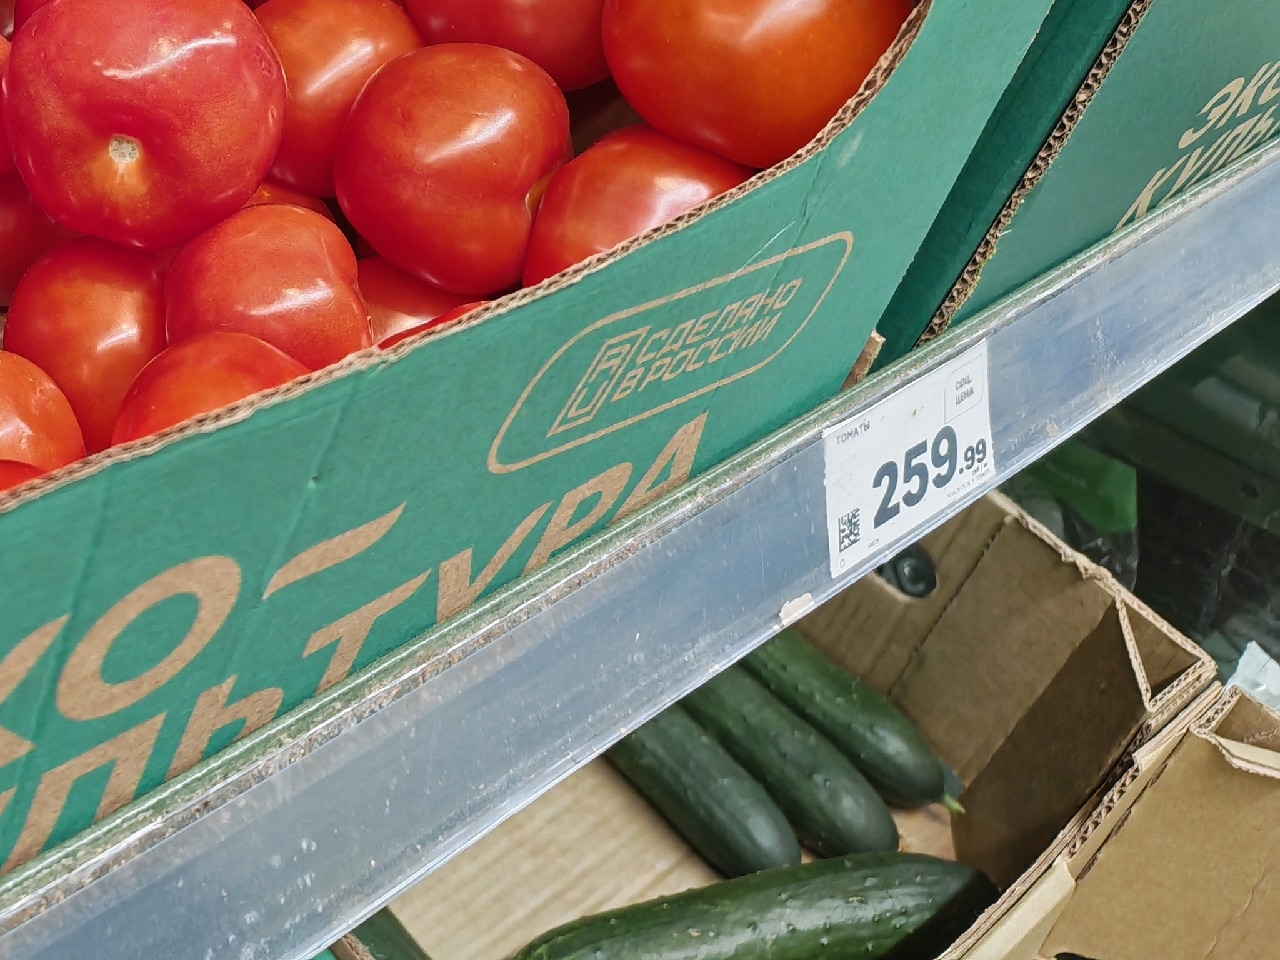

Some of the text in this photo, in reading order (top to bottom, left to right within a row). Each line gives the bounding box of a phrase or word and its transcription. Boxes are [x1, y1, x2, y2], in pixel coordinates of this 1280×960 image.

[1113, 102, 1280, 233] КУЛЬ
[635, 277, 804, 364] СДЕЛАНО
[835, 420, 870, 446] ТОМАТЫ
